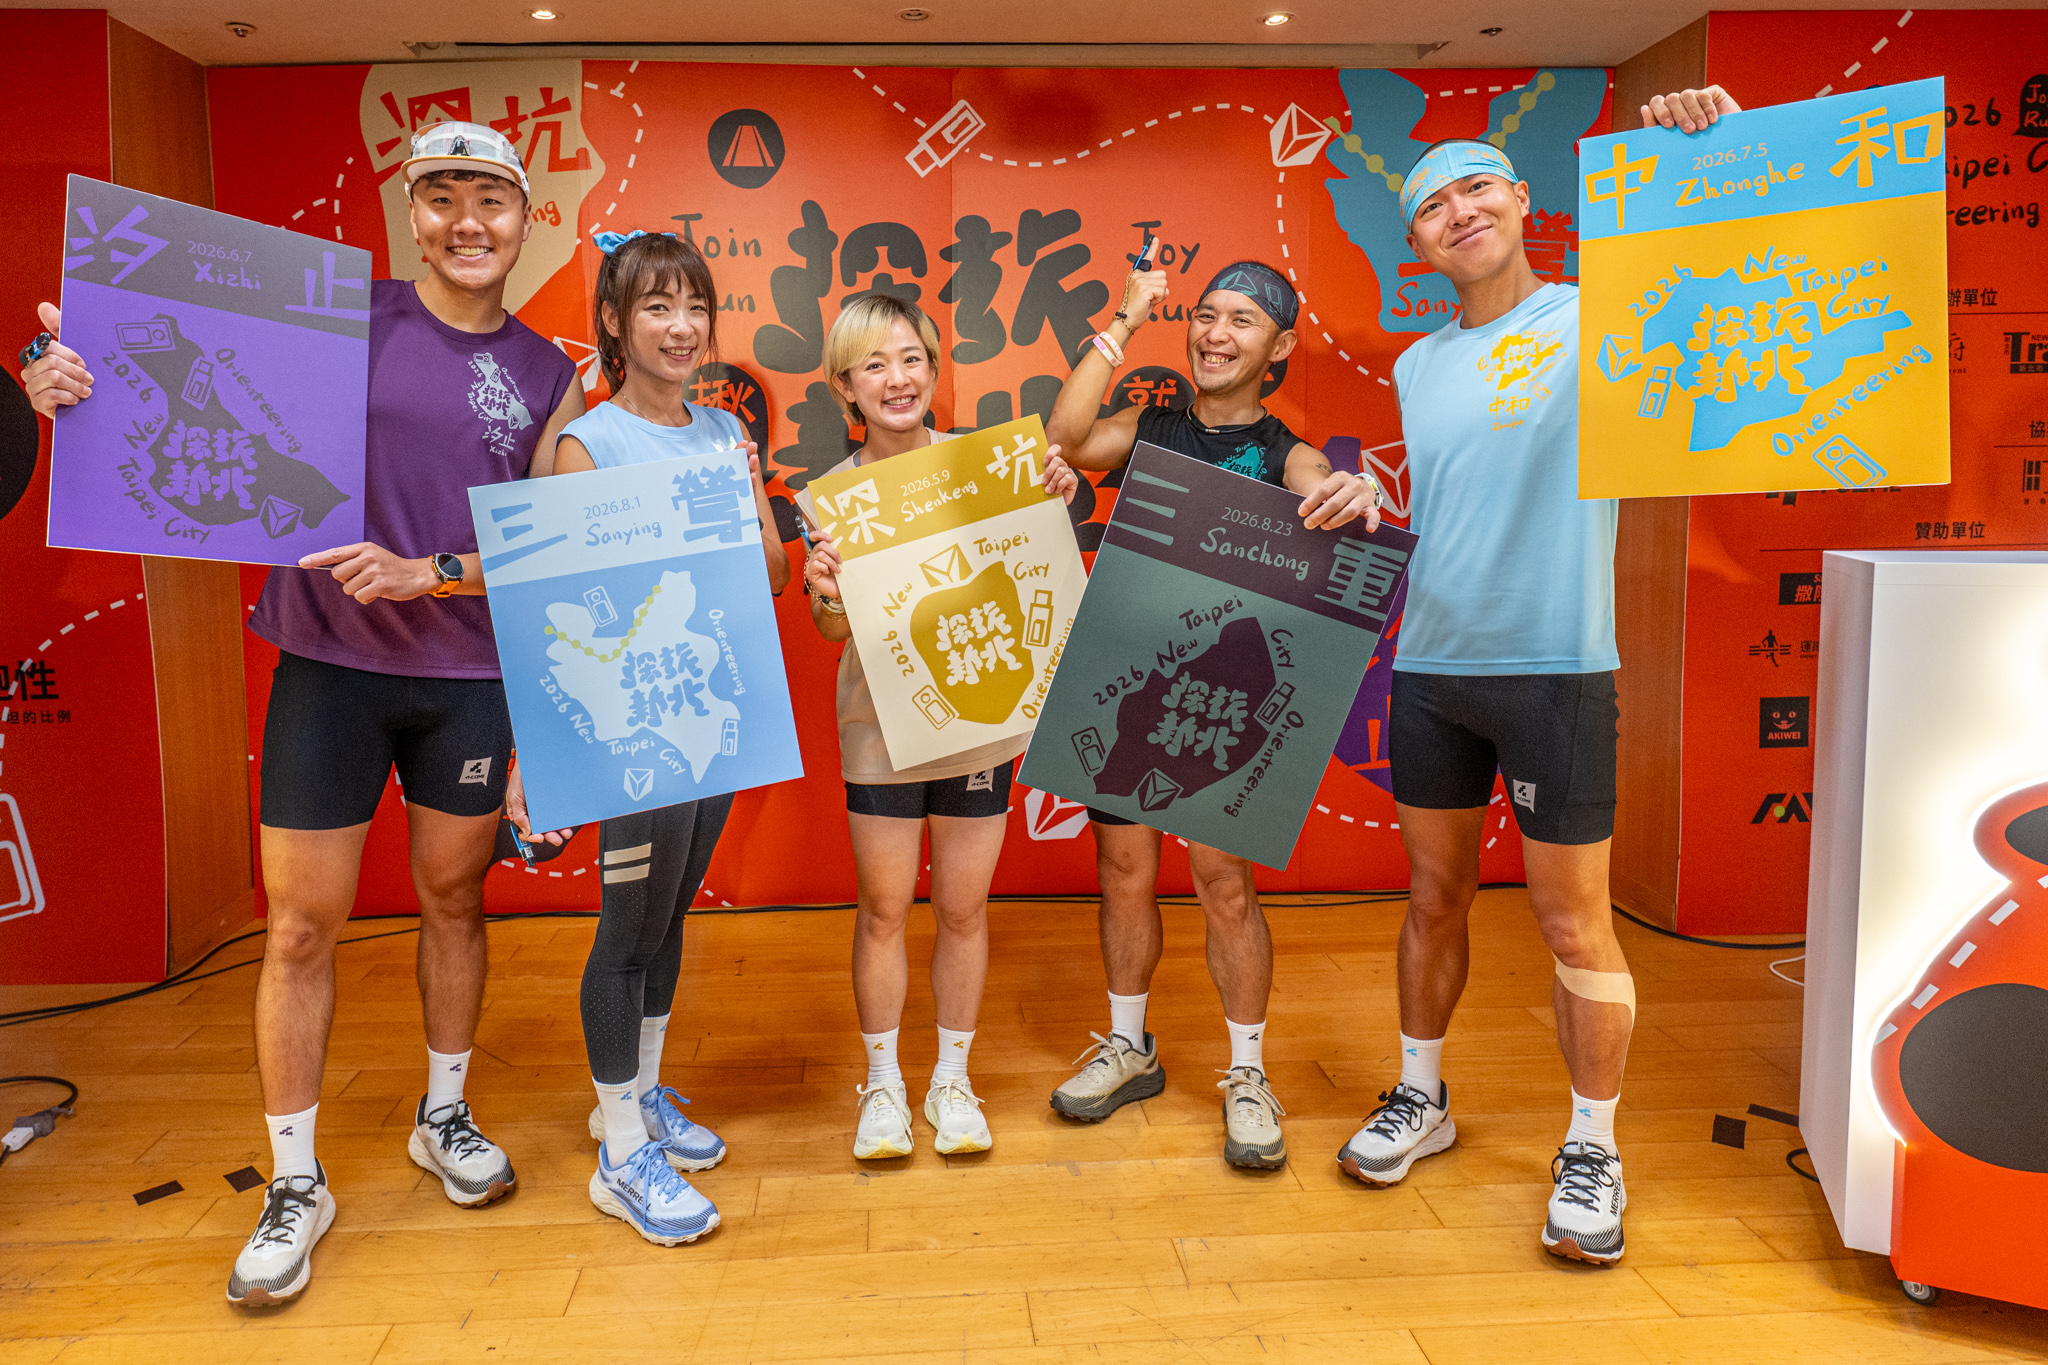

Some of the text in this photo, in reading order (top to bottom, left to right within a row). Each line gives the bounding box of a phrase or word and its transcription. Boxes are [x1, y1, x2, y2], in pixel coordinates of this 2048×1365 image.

[1945, 97, 2001, 128] 026
[1692, 142, 1768, 171] 2026.7.5
[1829, 106, 1945, 188] 和
[1585, 143, 1660, 229] 中
[1675, 160, 1805, 207] Zhonghe
[1946, 154, 2010, 189] ipei
[64, 204, 170, 285] 汐
[187, 240, 252, 263] 2026.6.7
[671, 213, 762, 258] Join
[1126, 220, 1200, 274] Joy
[194, 260, 261, 289] Xizhi
[284, 251, 371, 321] 止
[717, 293, 756, 313] un
[1391, 281, 1463, 322] Sany
[1628, 245, 1933, 457] 2026 New Taipei City Orienteering
[1489, 396, 1531, 419] 中和
[102, 348, 303, 544] 2026 New Taipei City Orienteering
[482, 425, 515, 450] 汐止
[2029, 420, 2048, 438] 協
[900, 469, 950, 497] 2026.5.9
[986, 433, 1044, 495] 坑
[583, 496, 641, 520] 2026.8.1
[816, 478, 896, 549] 深
[900, 480, 978, 523] Shenkeng
[1109, 470, 1190, 546] 三
[1220, 506, 1293, 536] 2026.8.23
[481, 503, 568, 574] 三
[585, 521, 663, 547] Sanying
[973, 532, 1030, 556] Taipei
[1199, 527, 1309, 581] Sanchong
[1013, 561, 1049, 581] City
[1314, 537, 1408, 621] 重
[882, 582, 912, 618] New
[882, 630, 914, 677] 2026
[539, 609, 746, 775] 2026 New Taipei City Orienteering
[1093, 595, 1304, 817] 2026 New Taipei City Orienteering
[1768, 731, 1801, 740] AKIWEI
[617, 1178, 651, 1212] MERREL
